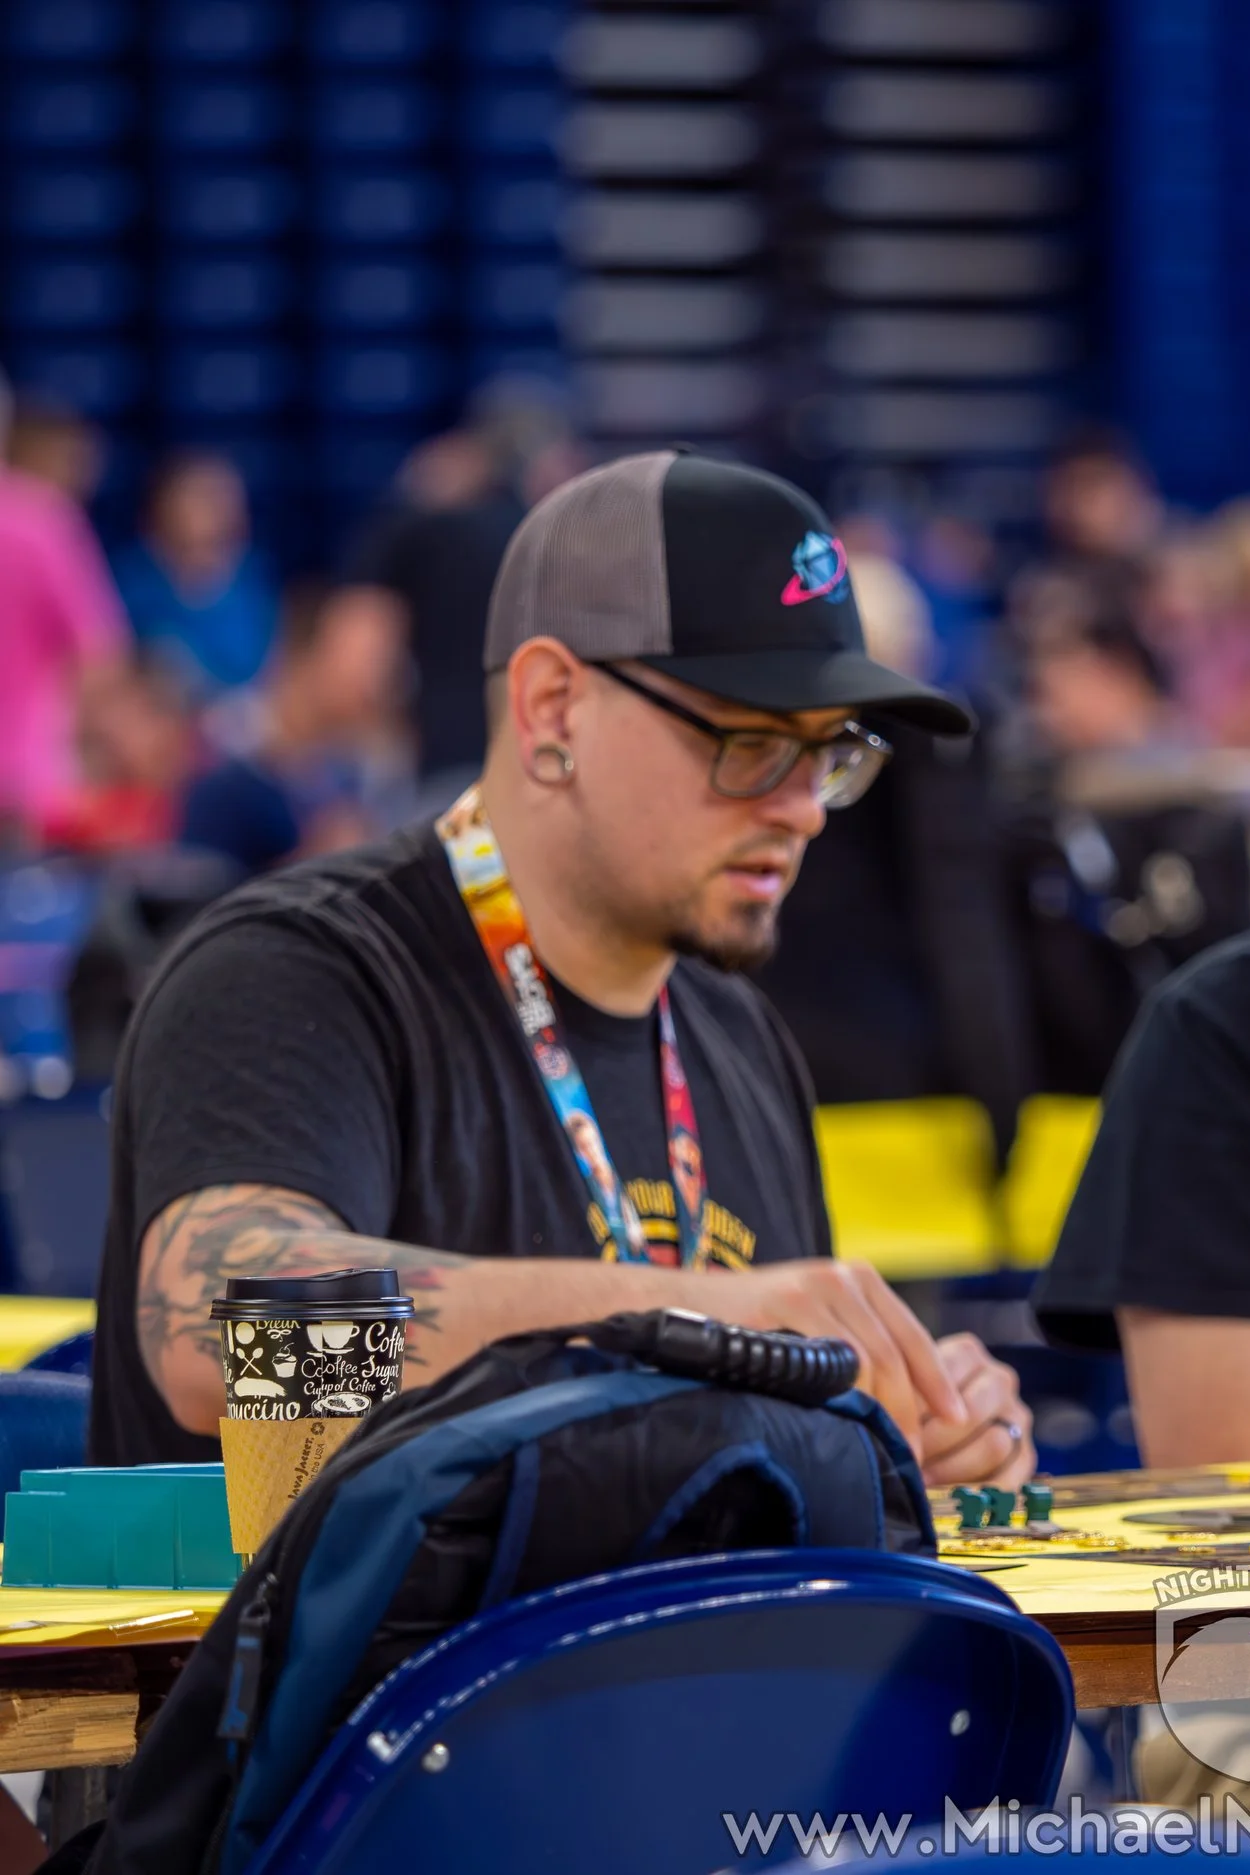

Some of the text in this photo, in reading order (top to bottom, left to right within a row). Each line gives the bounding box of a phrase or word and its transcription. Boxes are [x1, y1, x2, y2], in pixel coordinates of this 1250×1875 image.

[361, 1355, 400, 1386] Sugar
[349, 1377, 377, 1393] Coffee
[314, 1443, 325, 1460] USA
